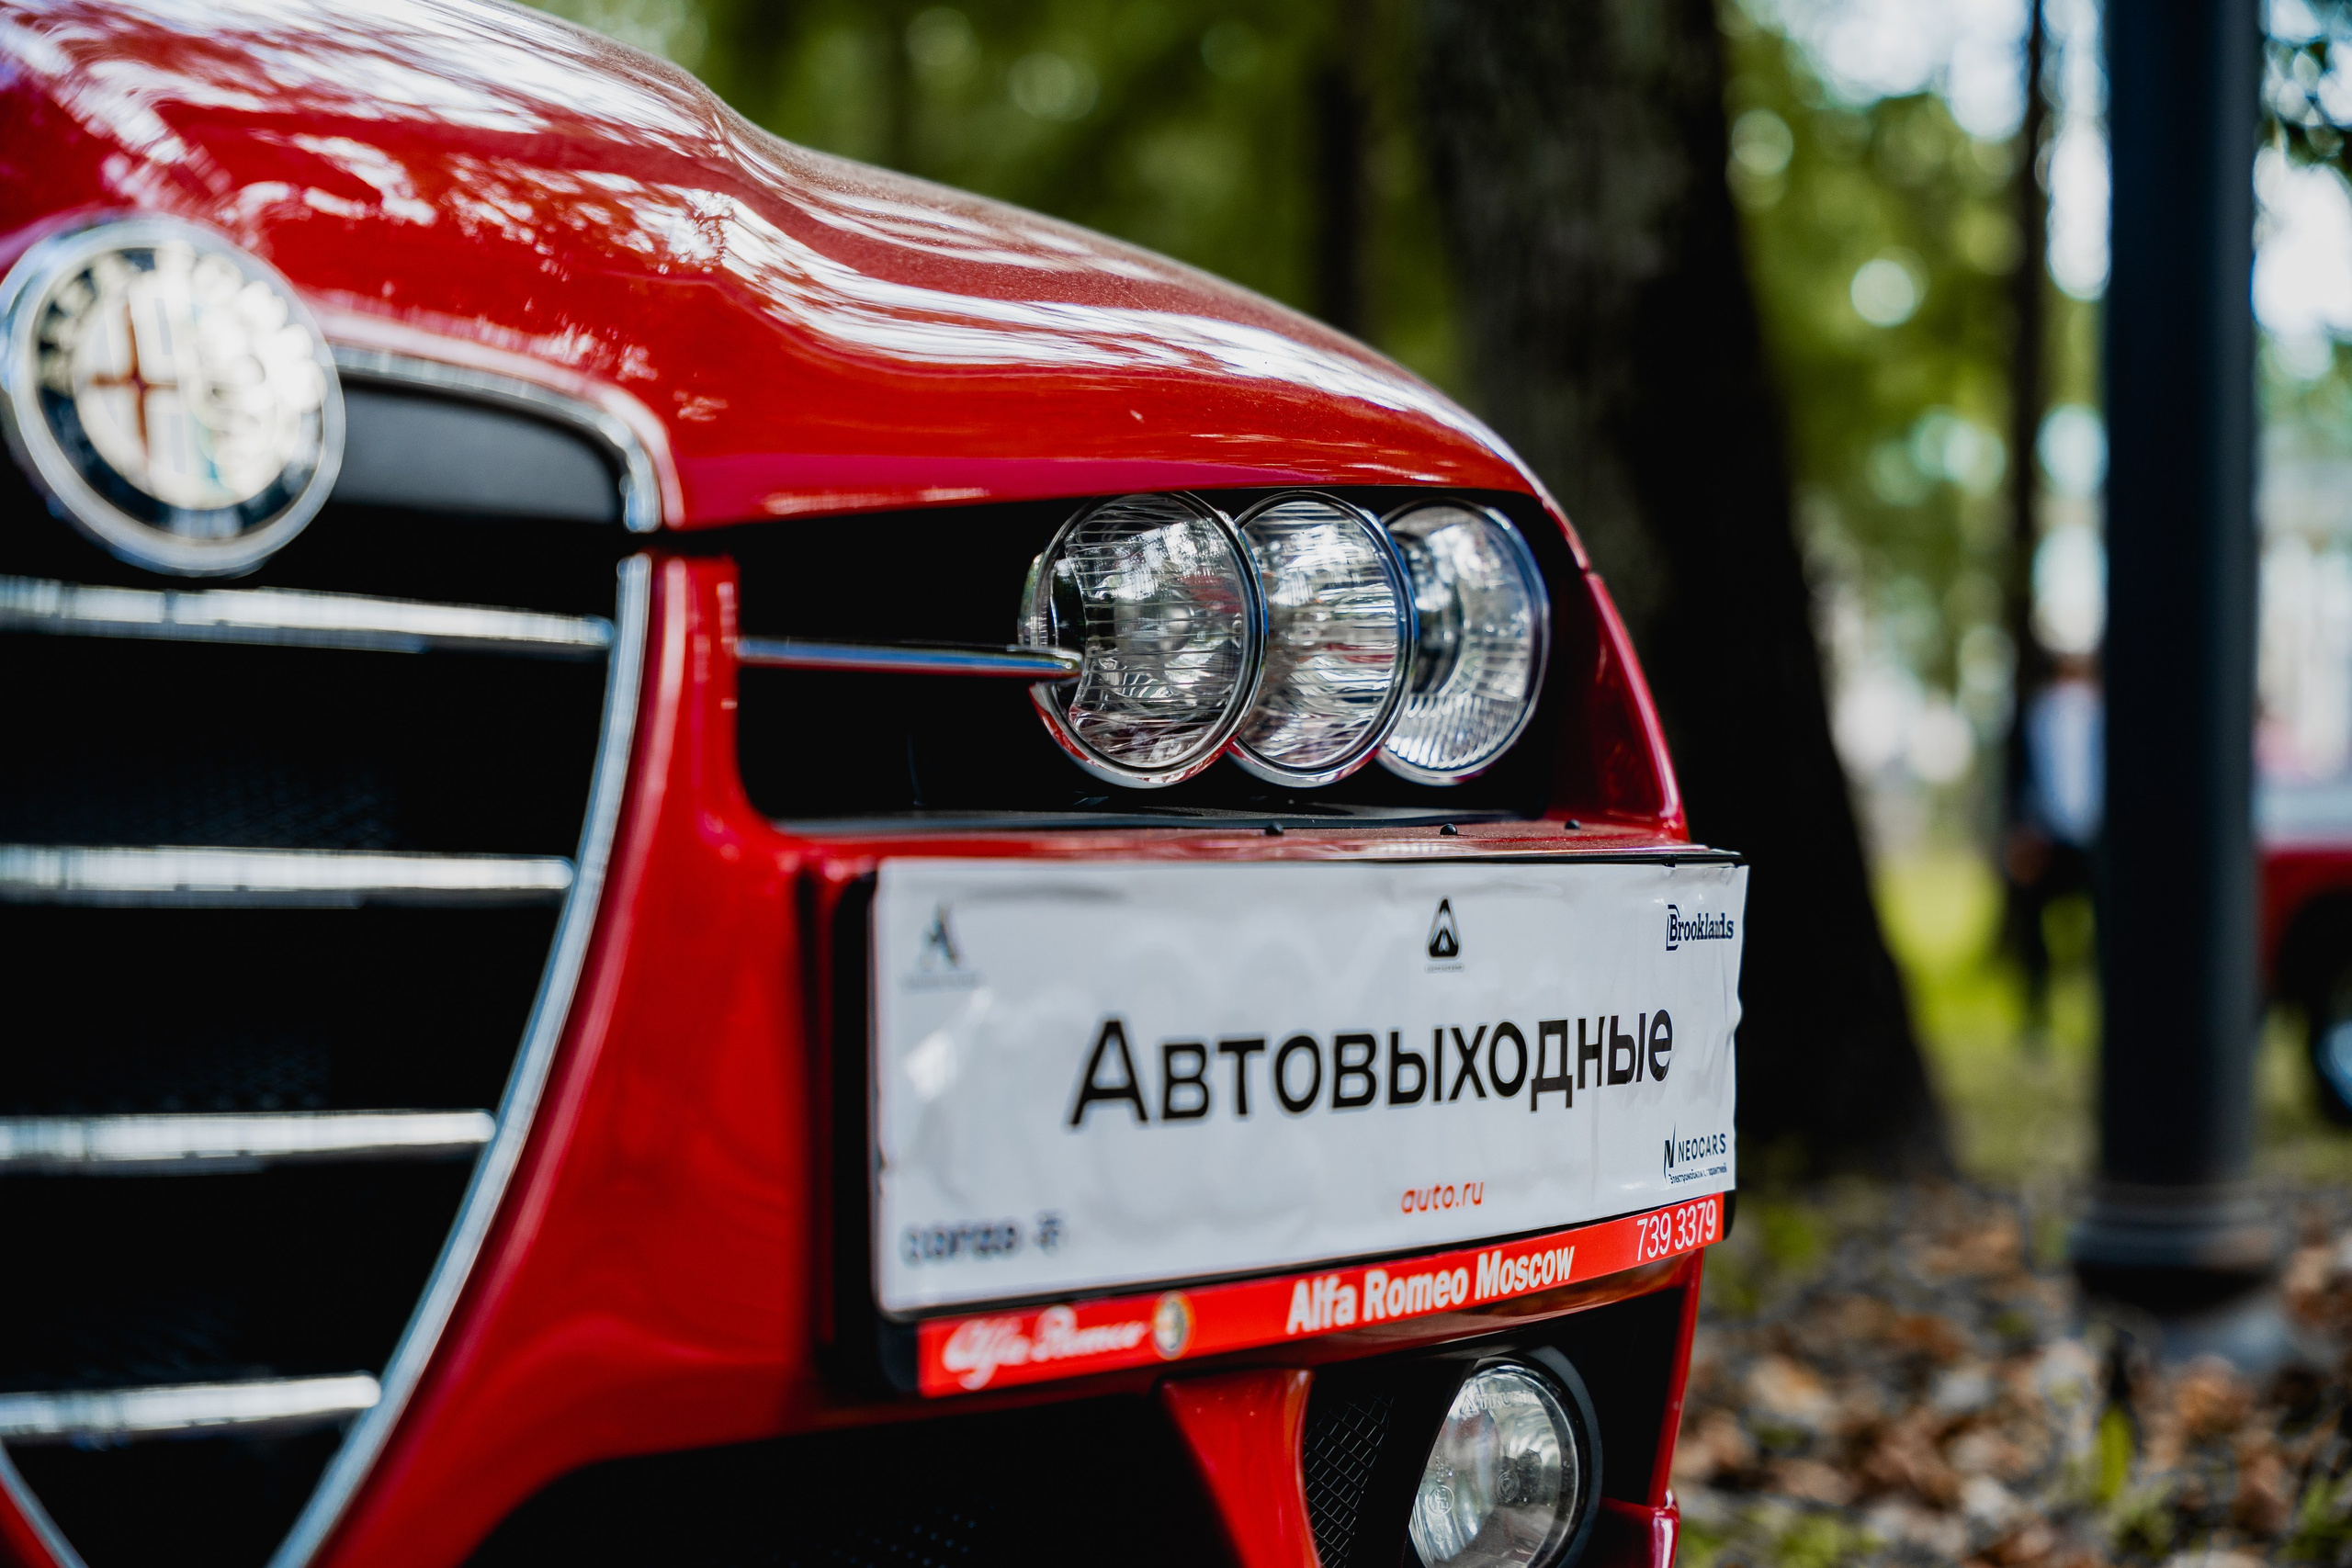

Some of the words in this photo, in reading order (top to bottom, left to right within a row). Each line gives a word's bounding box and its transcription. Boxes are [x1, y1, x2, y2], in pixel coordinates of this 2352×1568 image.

[1667, 911, 1735, 942] Brooklands
[1068, 1009, 1673, 1126] Автовыходные
[1678, 1133, 1727, 1163] NEOCARS
[1401, 1181, 1484, 1214] auto.ru
[1637, 1213, 1671, 1261] 739
[1674, 1199, 1716, 1250] 3379
[1287, 1275, 1358, 1335] Alfa
[1363, 1269, 1469, 1321] Romeo
[1474, 1246, 1575, 1300] Moscow
